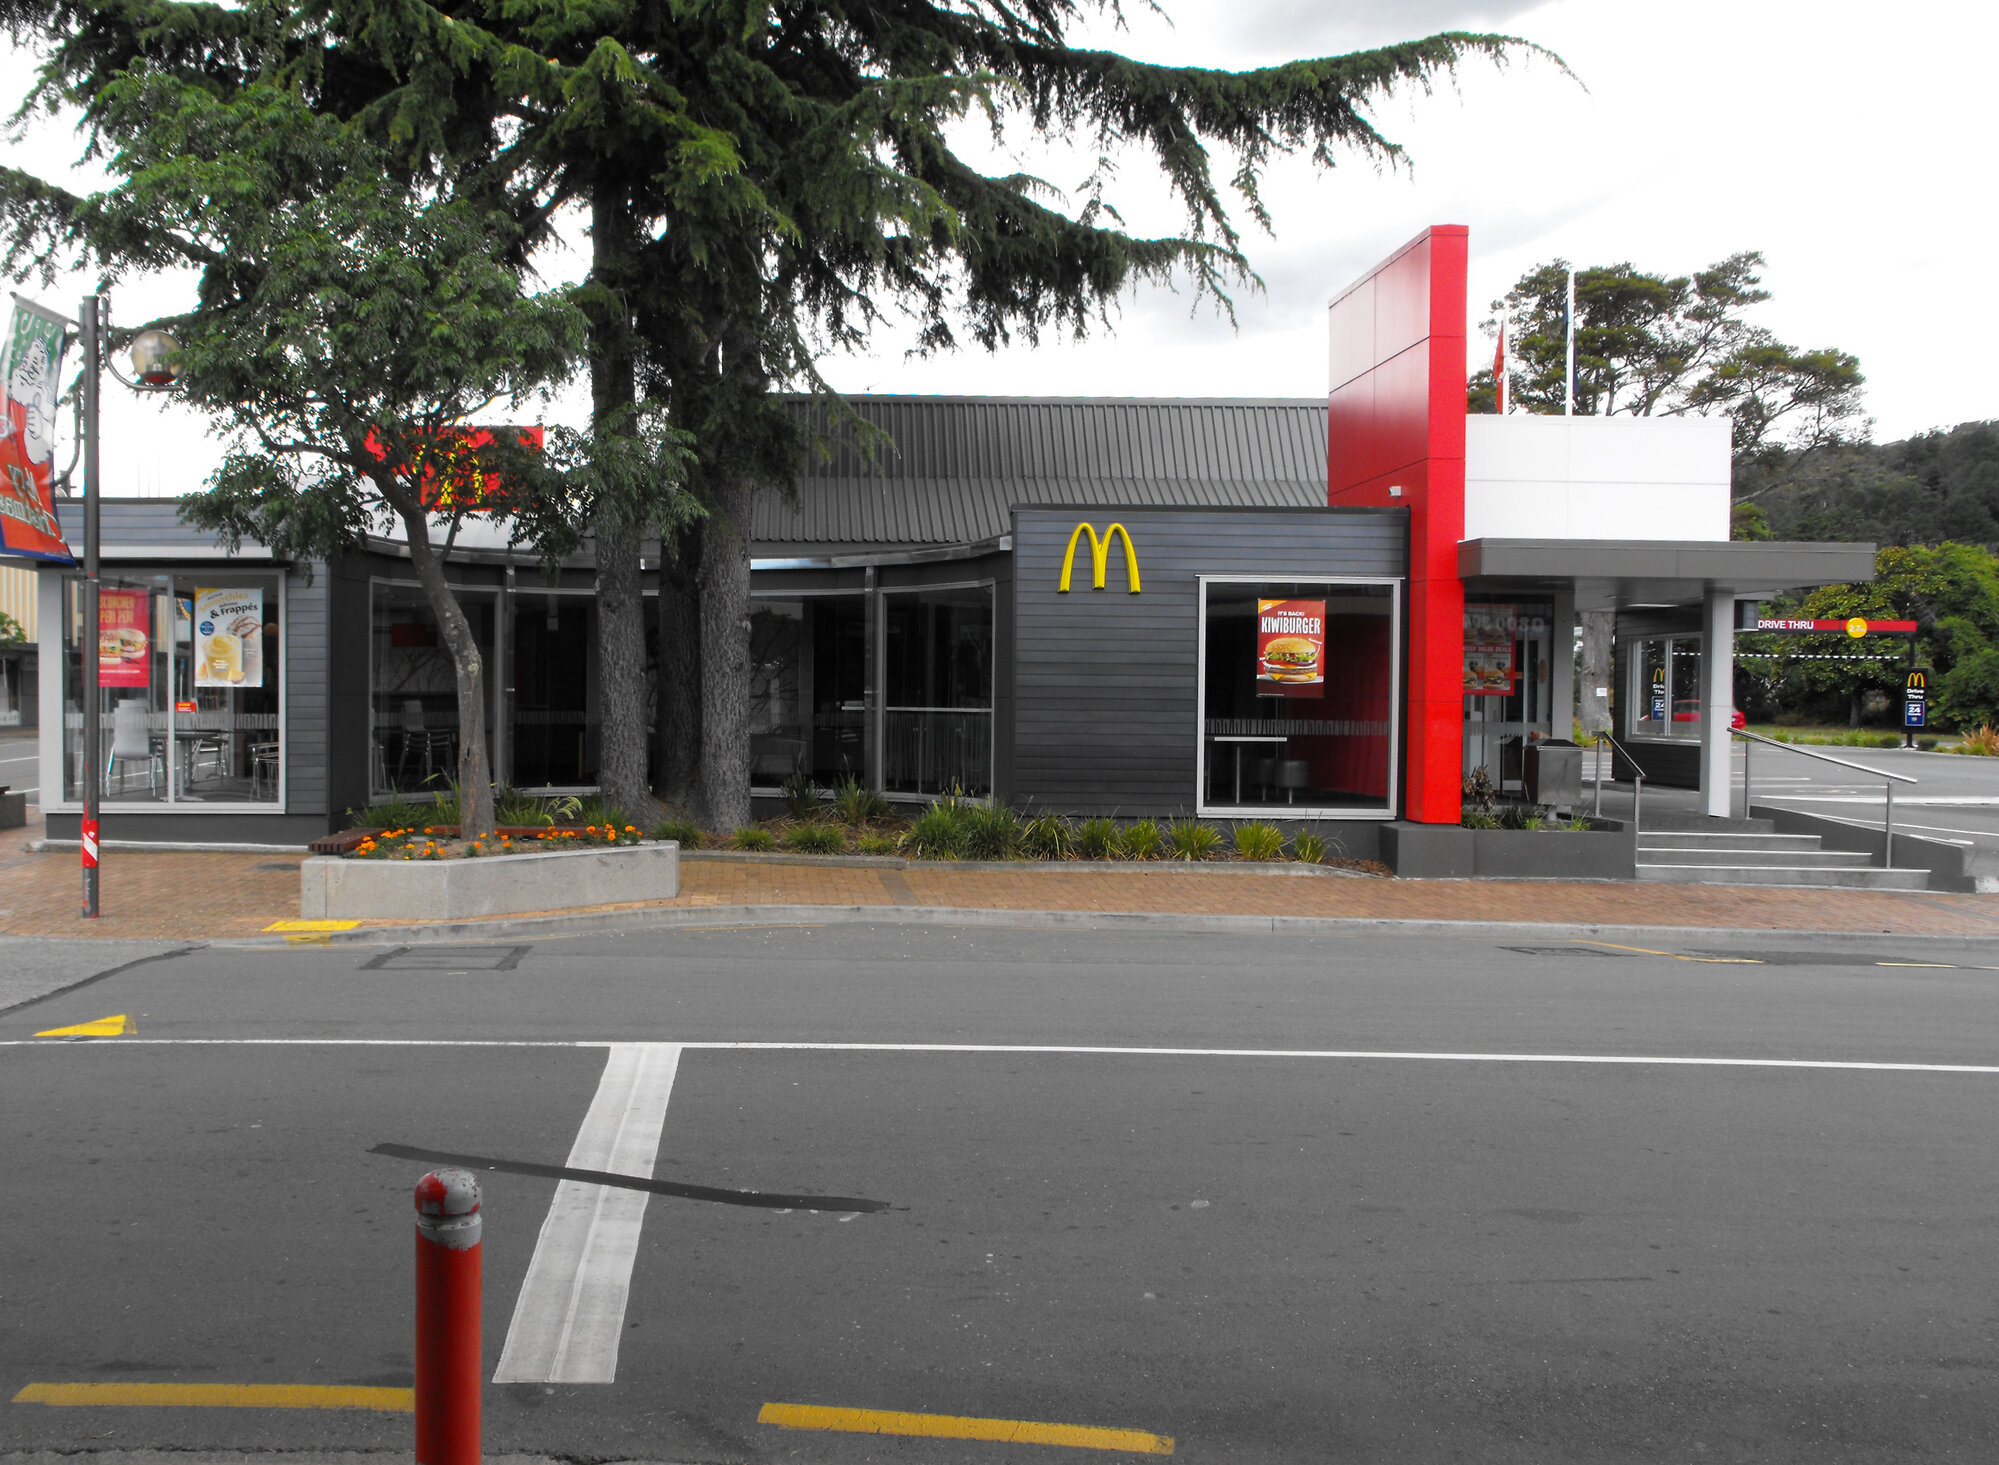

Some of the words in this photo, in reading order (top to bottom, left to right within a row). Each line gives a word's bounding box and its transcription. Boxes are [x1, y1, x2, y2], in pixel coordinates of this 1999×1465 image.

[1261, 616, 1321, 634] KIWIBURGER
[1757, 619, 1786, 629] DRIVE
[1788, 620, 1814, 630] THRU
